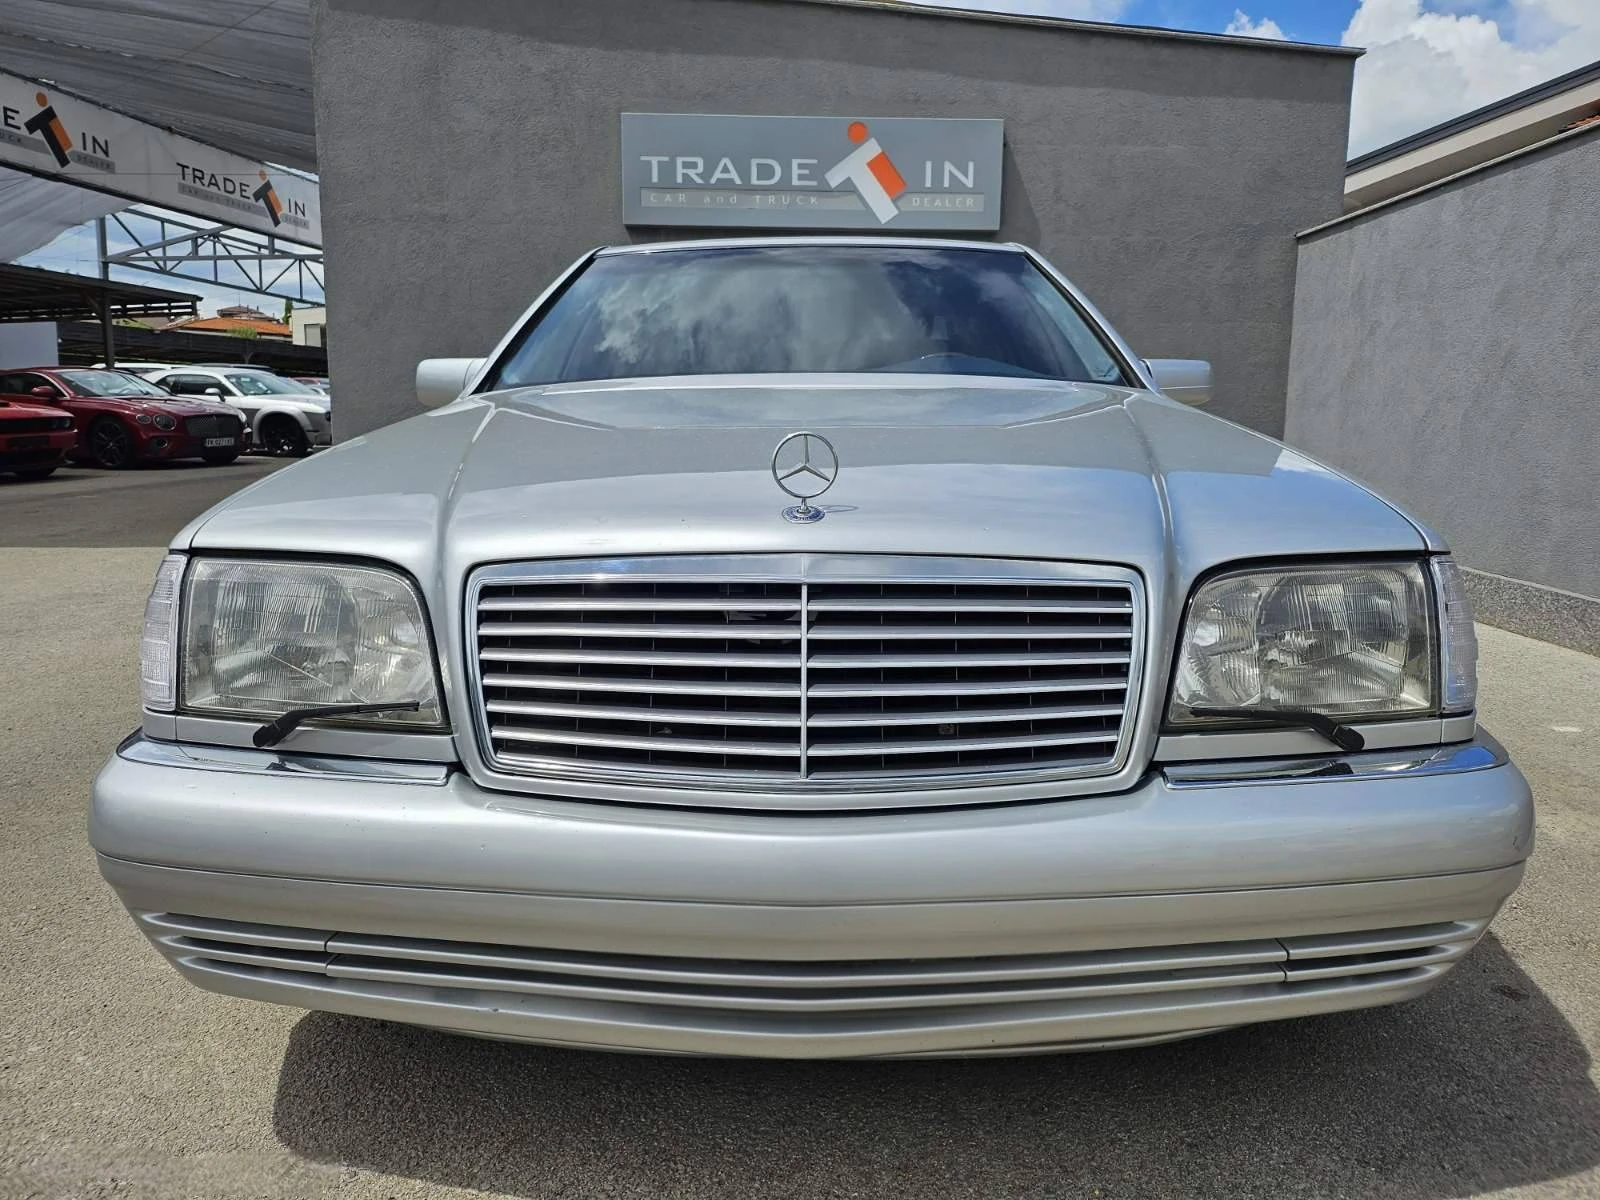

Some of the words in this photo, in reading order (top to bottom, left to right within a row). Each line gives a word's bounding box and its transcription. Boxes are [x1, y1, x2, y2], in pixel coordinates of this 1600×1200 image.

[82, 132, 109, 157] IN
[640, 155, 818, 186] TRADE
[925, 161, 975, 188] IN
[176, 162, 251, 200] TRADE
[288, 198, 306, 218] IN
[650, 193, 687, 203] CAR
[703, 195, 737, 204] and
[755, 195, 819, 205] TRUCK
[912, 197, 975, 208] DEALER
